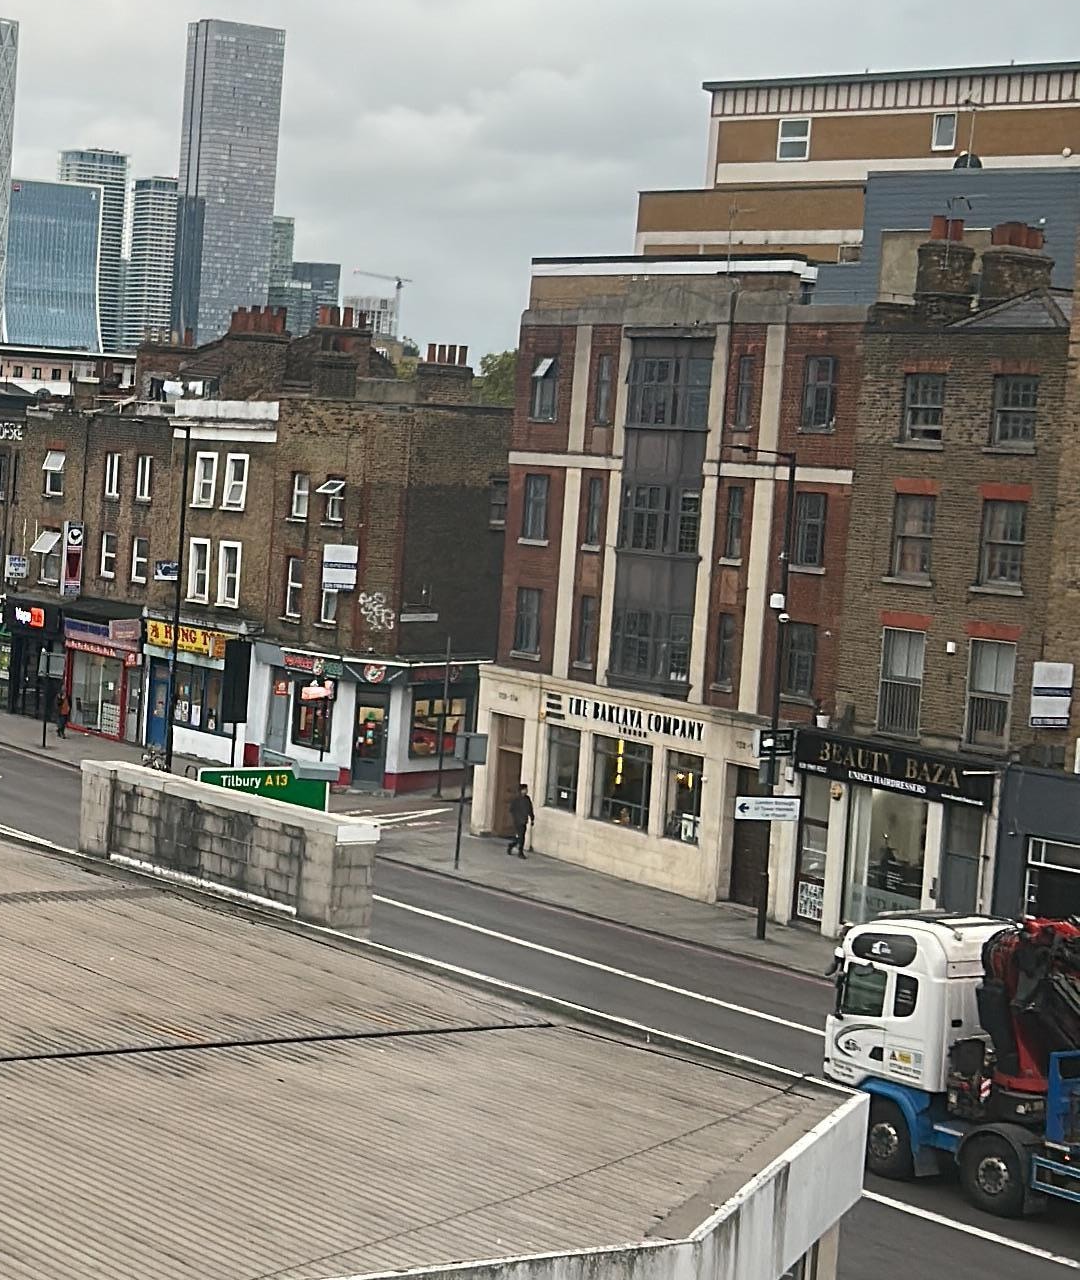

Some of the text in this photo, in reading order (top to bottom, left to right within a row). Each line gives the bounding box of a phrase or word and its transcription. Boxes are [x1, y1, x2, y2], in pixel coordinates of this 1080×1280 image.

[165, 625, 197, 644] HNG
[569, 697, 704, 741] THE BAKLAVA COMPANY
[820, 741, 894, 775] BEAUTY
[905, 757, 960, 789] BAZA
[220, 774, 288, 788] Tilbury A13
[848, 770, 927, 794] UNISEX HAIRDRESSERS
